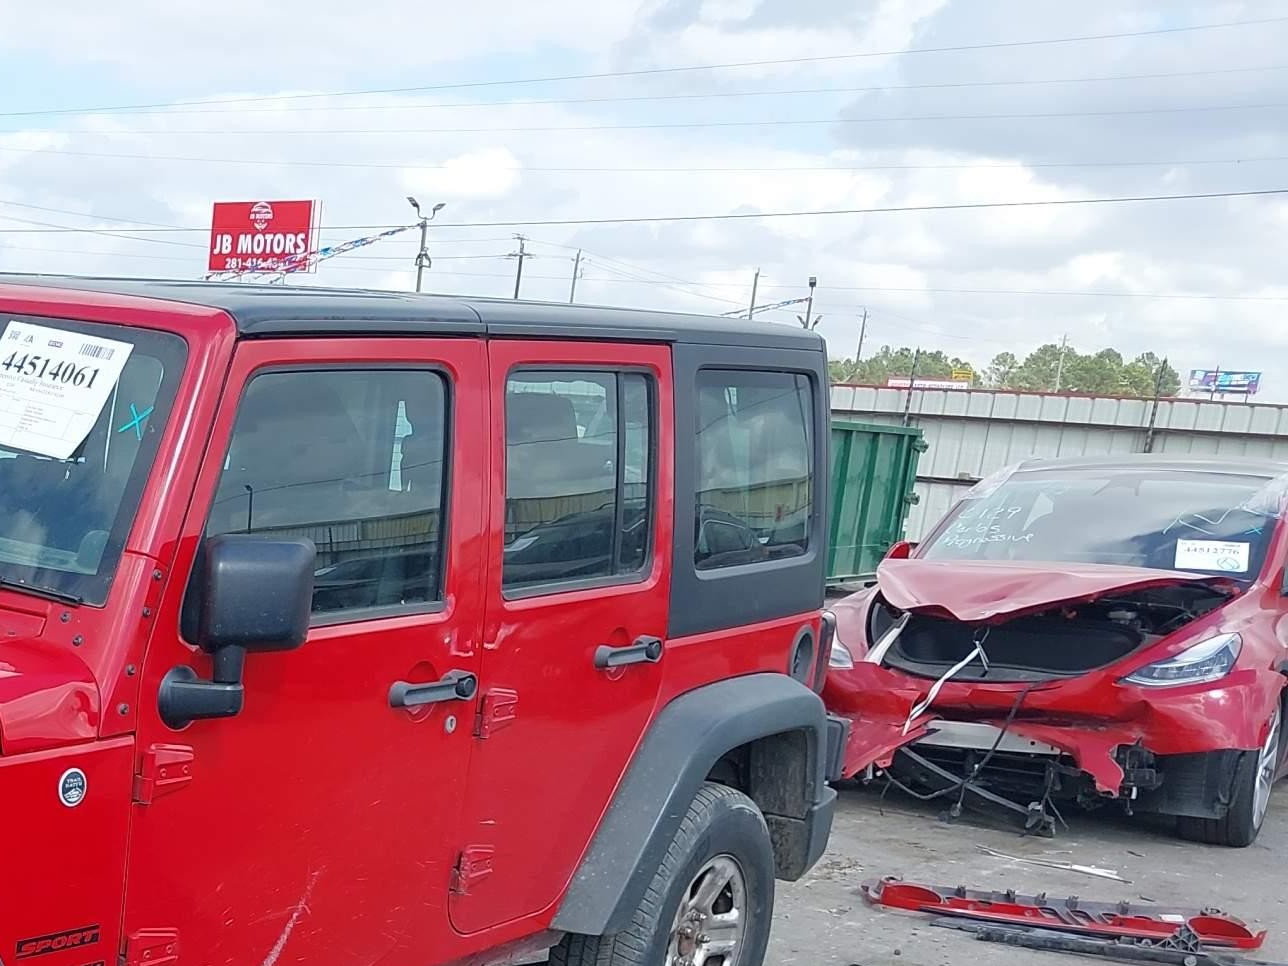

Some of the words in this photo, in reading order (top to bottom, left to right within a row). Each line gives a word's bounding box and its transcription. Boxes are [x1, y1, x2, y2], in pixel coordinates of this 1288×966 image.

[213, 234, 232, 254] JB
[237, 233, 306, 254] MOTORS
[1, 350, 100, 389] 44514061
[19, 929, 100, 955] SPORT
